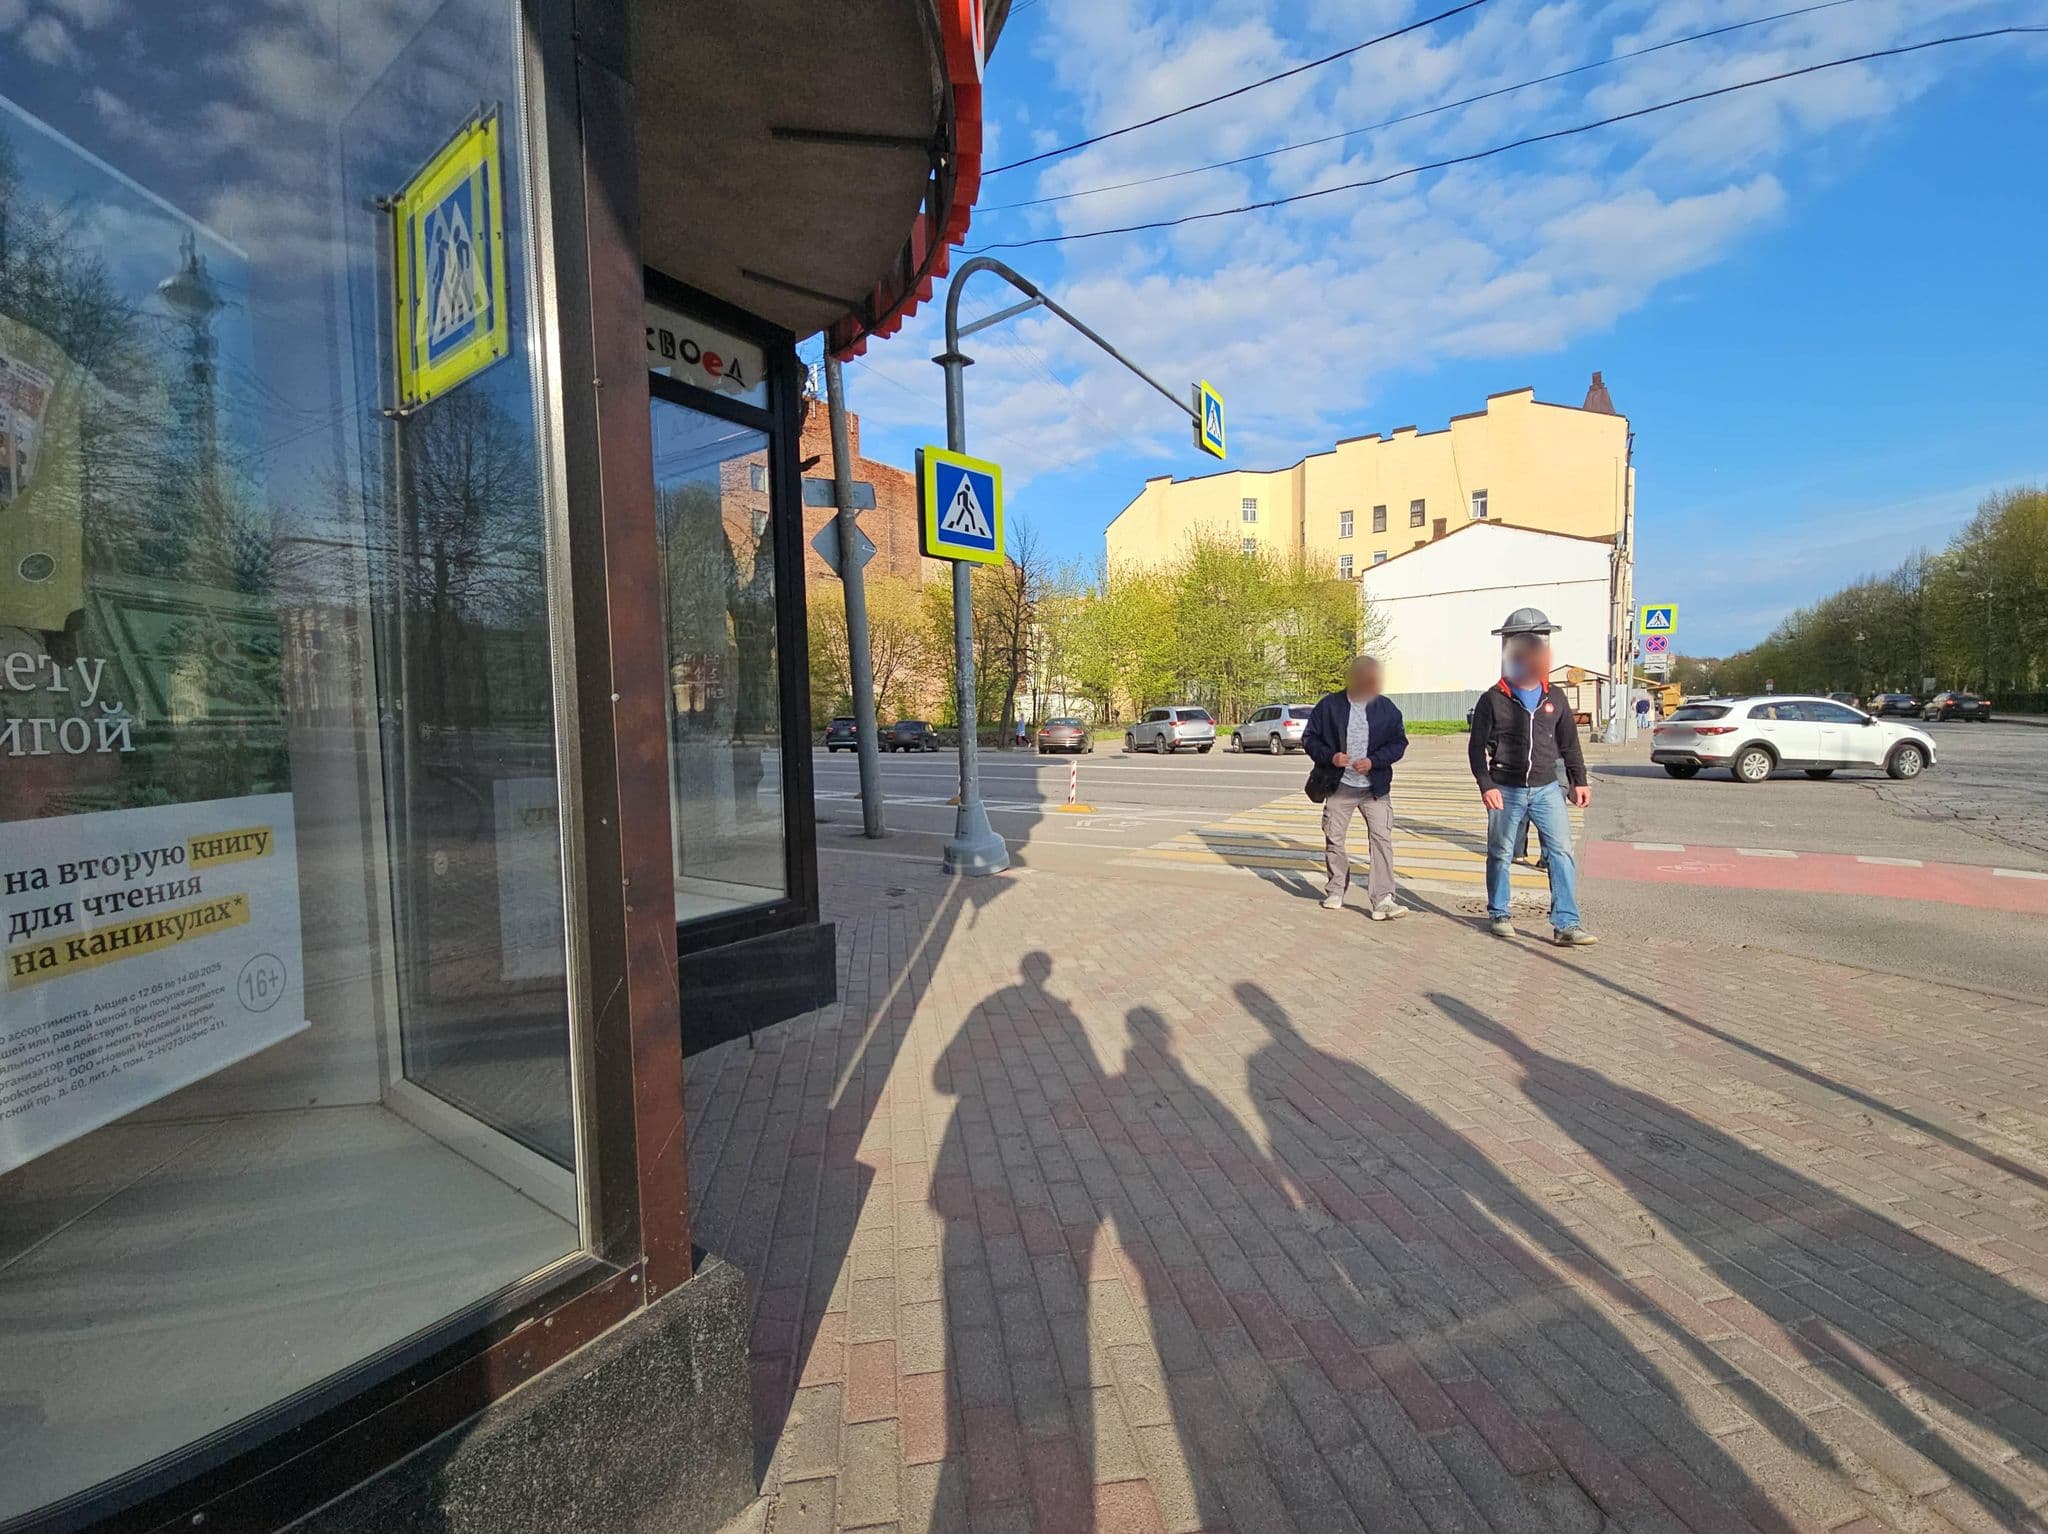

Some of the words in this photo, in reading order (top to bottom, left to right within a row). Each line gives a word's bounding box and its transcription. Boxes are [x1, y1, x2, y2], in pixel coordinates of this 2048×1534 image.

[0, 651, 106, 708] ету
[5, 869, 49, 895] на
[58, 844, 186, 886] вторую
[191, 831, 269, 861] книгу
[9, 902, 75, 943] для
[83, 876, 202, 917] чтения
[11, 945, 56, 977] на
[94, 995, 128, 1014] Акция
[246, 968, 279, 1001] 16+
[28, 1037, 50, 1050] или
[53, 1020, 93, 1043] равной
[95, 1009, 127, 1026] ценой
[129, 1003, 148, 1015] при
[56, 1043, 71, 1054] не
[73, 1022, 132, 1051] действуют.
[134, 1006, 170, 1026] Бонусы
[66, 1045, 104, 1066] вправе
[106, 1030, 142, 1050] менять
[69, 1060, 94, 1077] ООО
